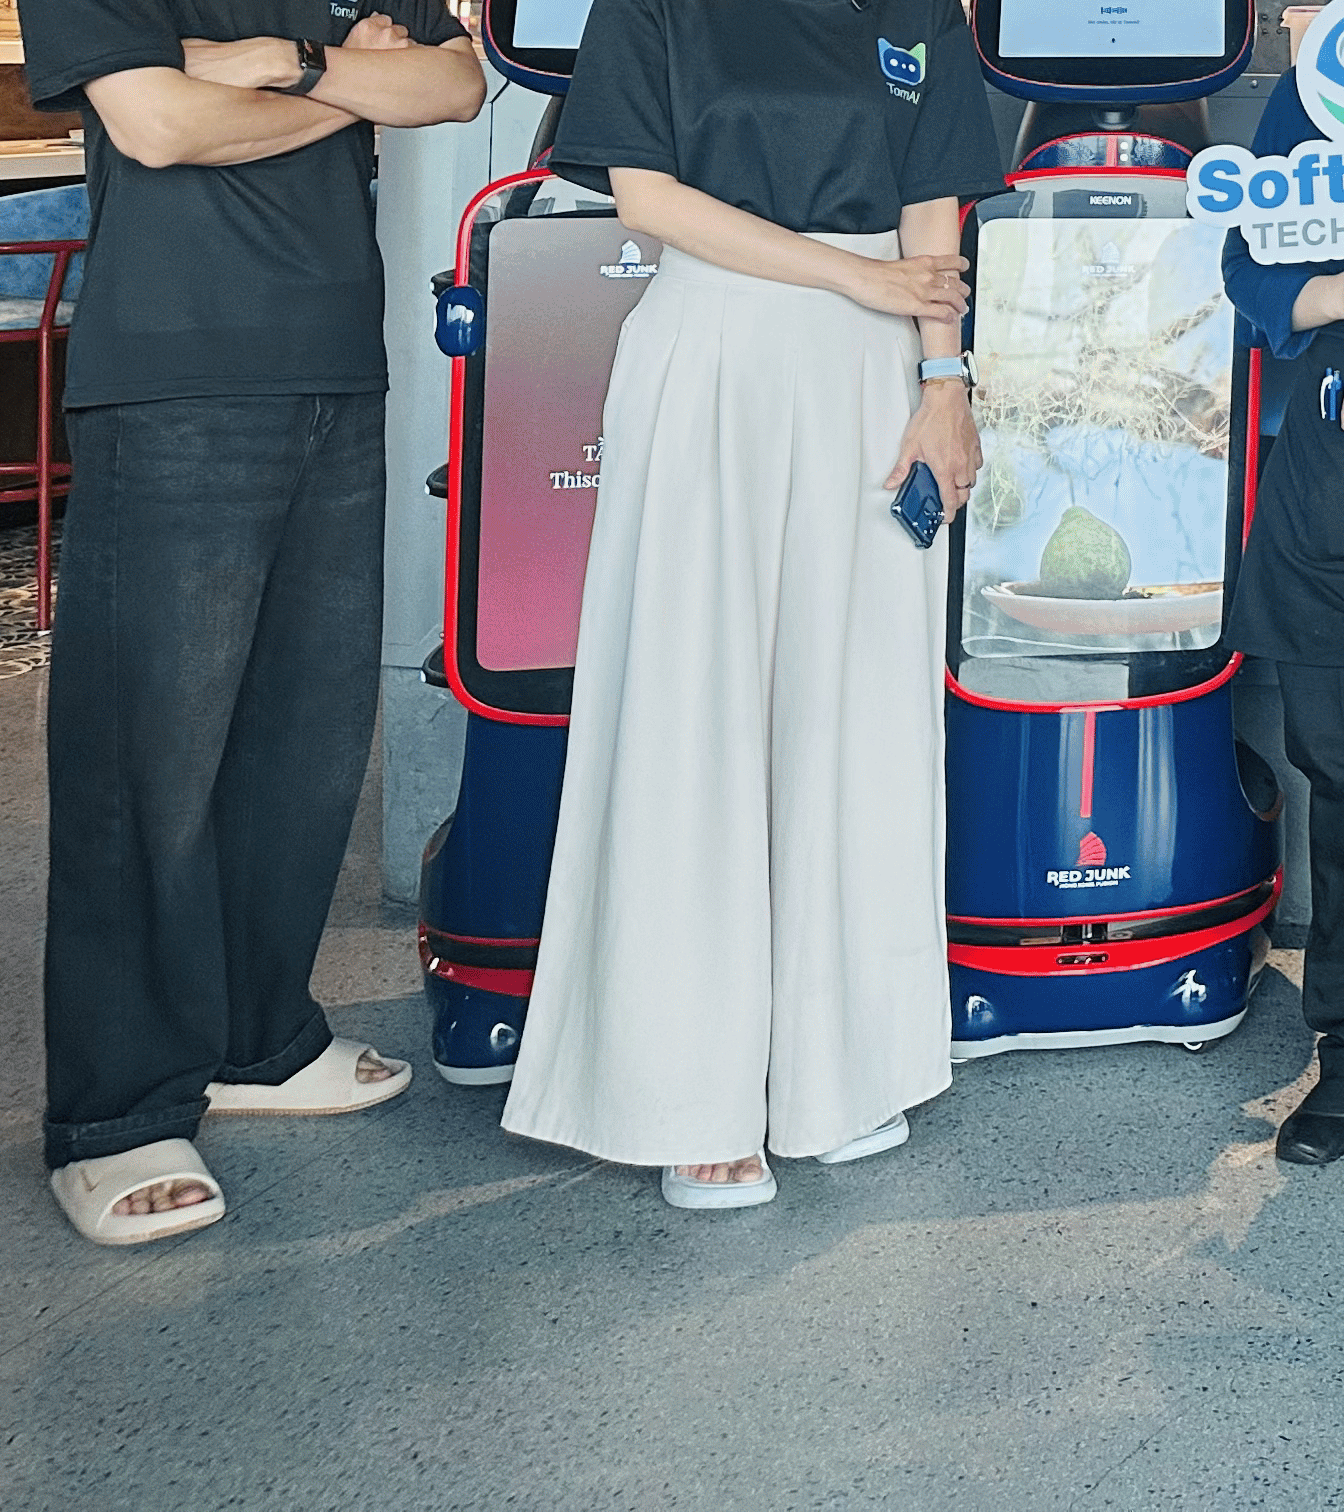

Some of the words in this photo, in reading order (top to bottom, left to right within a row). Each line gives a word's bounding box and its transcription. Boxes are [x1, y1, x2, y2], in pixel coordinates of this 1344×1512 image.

[885, 81, 921, 105] TomAI
[1089, 195, 1132, 205] KEENON
[1046, 870, 1083, 887] RED
[1084, 865, 1132, 882] JUNK
